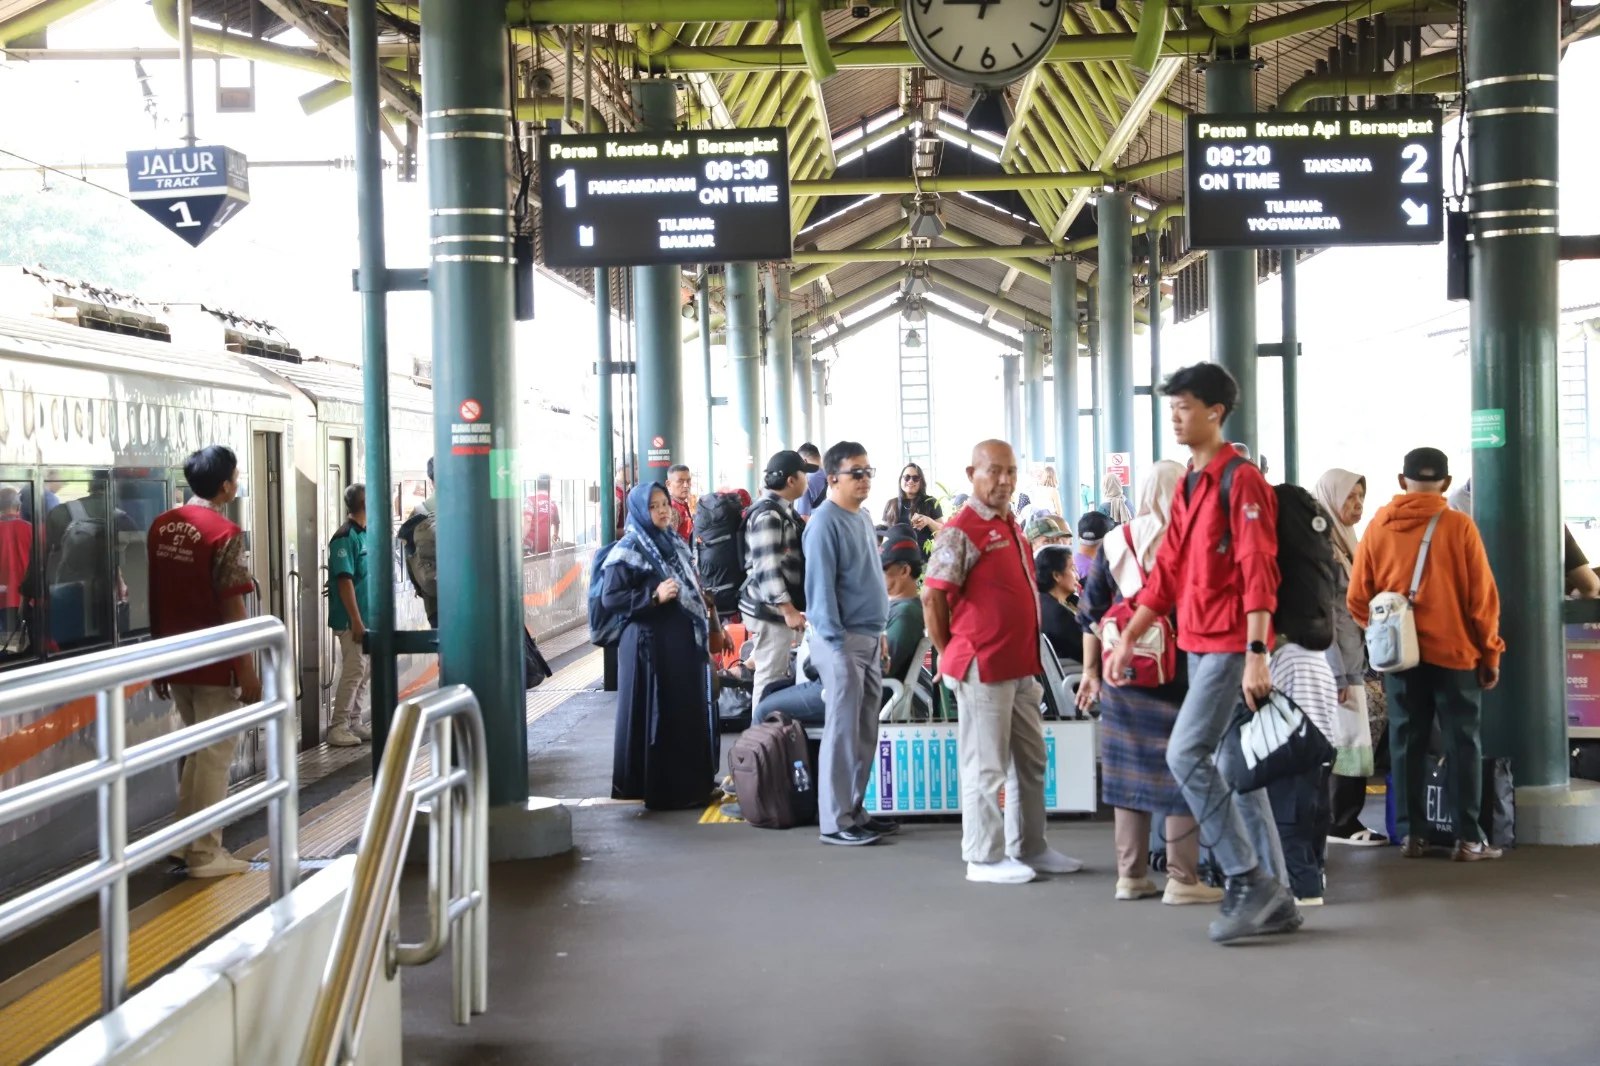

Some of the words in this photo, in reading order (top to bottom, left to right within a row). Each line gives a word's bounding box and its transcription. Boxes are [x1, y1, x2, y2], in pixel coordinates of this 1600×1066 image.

[980, 46, 996, 70] 6
[1198, 123, 1247, 139] Peron
[1256, 122, 1309, 137] Kereta
[1312, 120, 1341, 139] Api
[1349, 118, 1433, 138] Berangkat
[606, 141, 658, 158] Kereta
[661, 140, 689, 158] Api
[697, 137, 779, 156] Berangkat
[1206, 146, 1271, 167] 09:20
[138, 151, 217, 175] JALUR
[705, 159, 768, 181] 09:30
[1303, 158, 1372, 174] TAKSAKA
[1400, 144, 1429, 184] 2
[156, 176, 200, 188] TRACK
[556, 169, 577, 208] 1
[1200, 173, 1228, 191] ON
[1233, 172, 1280, 190] TIME
[699, 187, 728, 205] ON
[732, 185, 779, 203] TIME
[168, 201, 201, 228] 1
[1247, 216, 1341, 231] YOGYAKARTA
[159, 521, 201, 543] PORTER
[882, 747, 889, 756] 2
[1436, 823, 1453, 833] PAR
